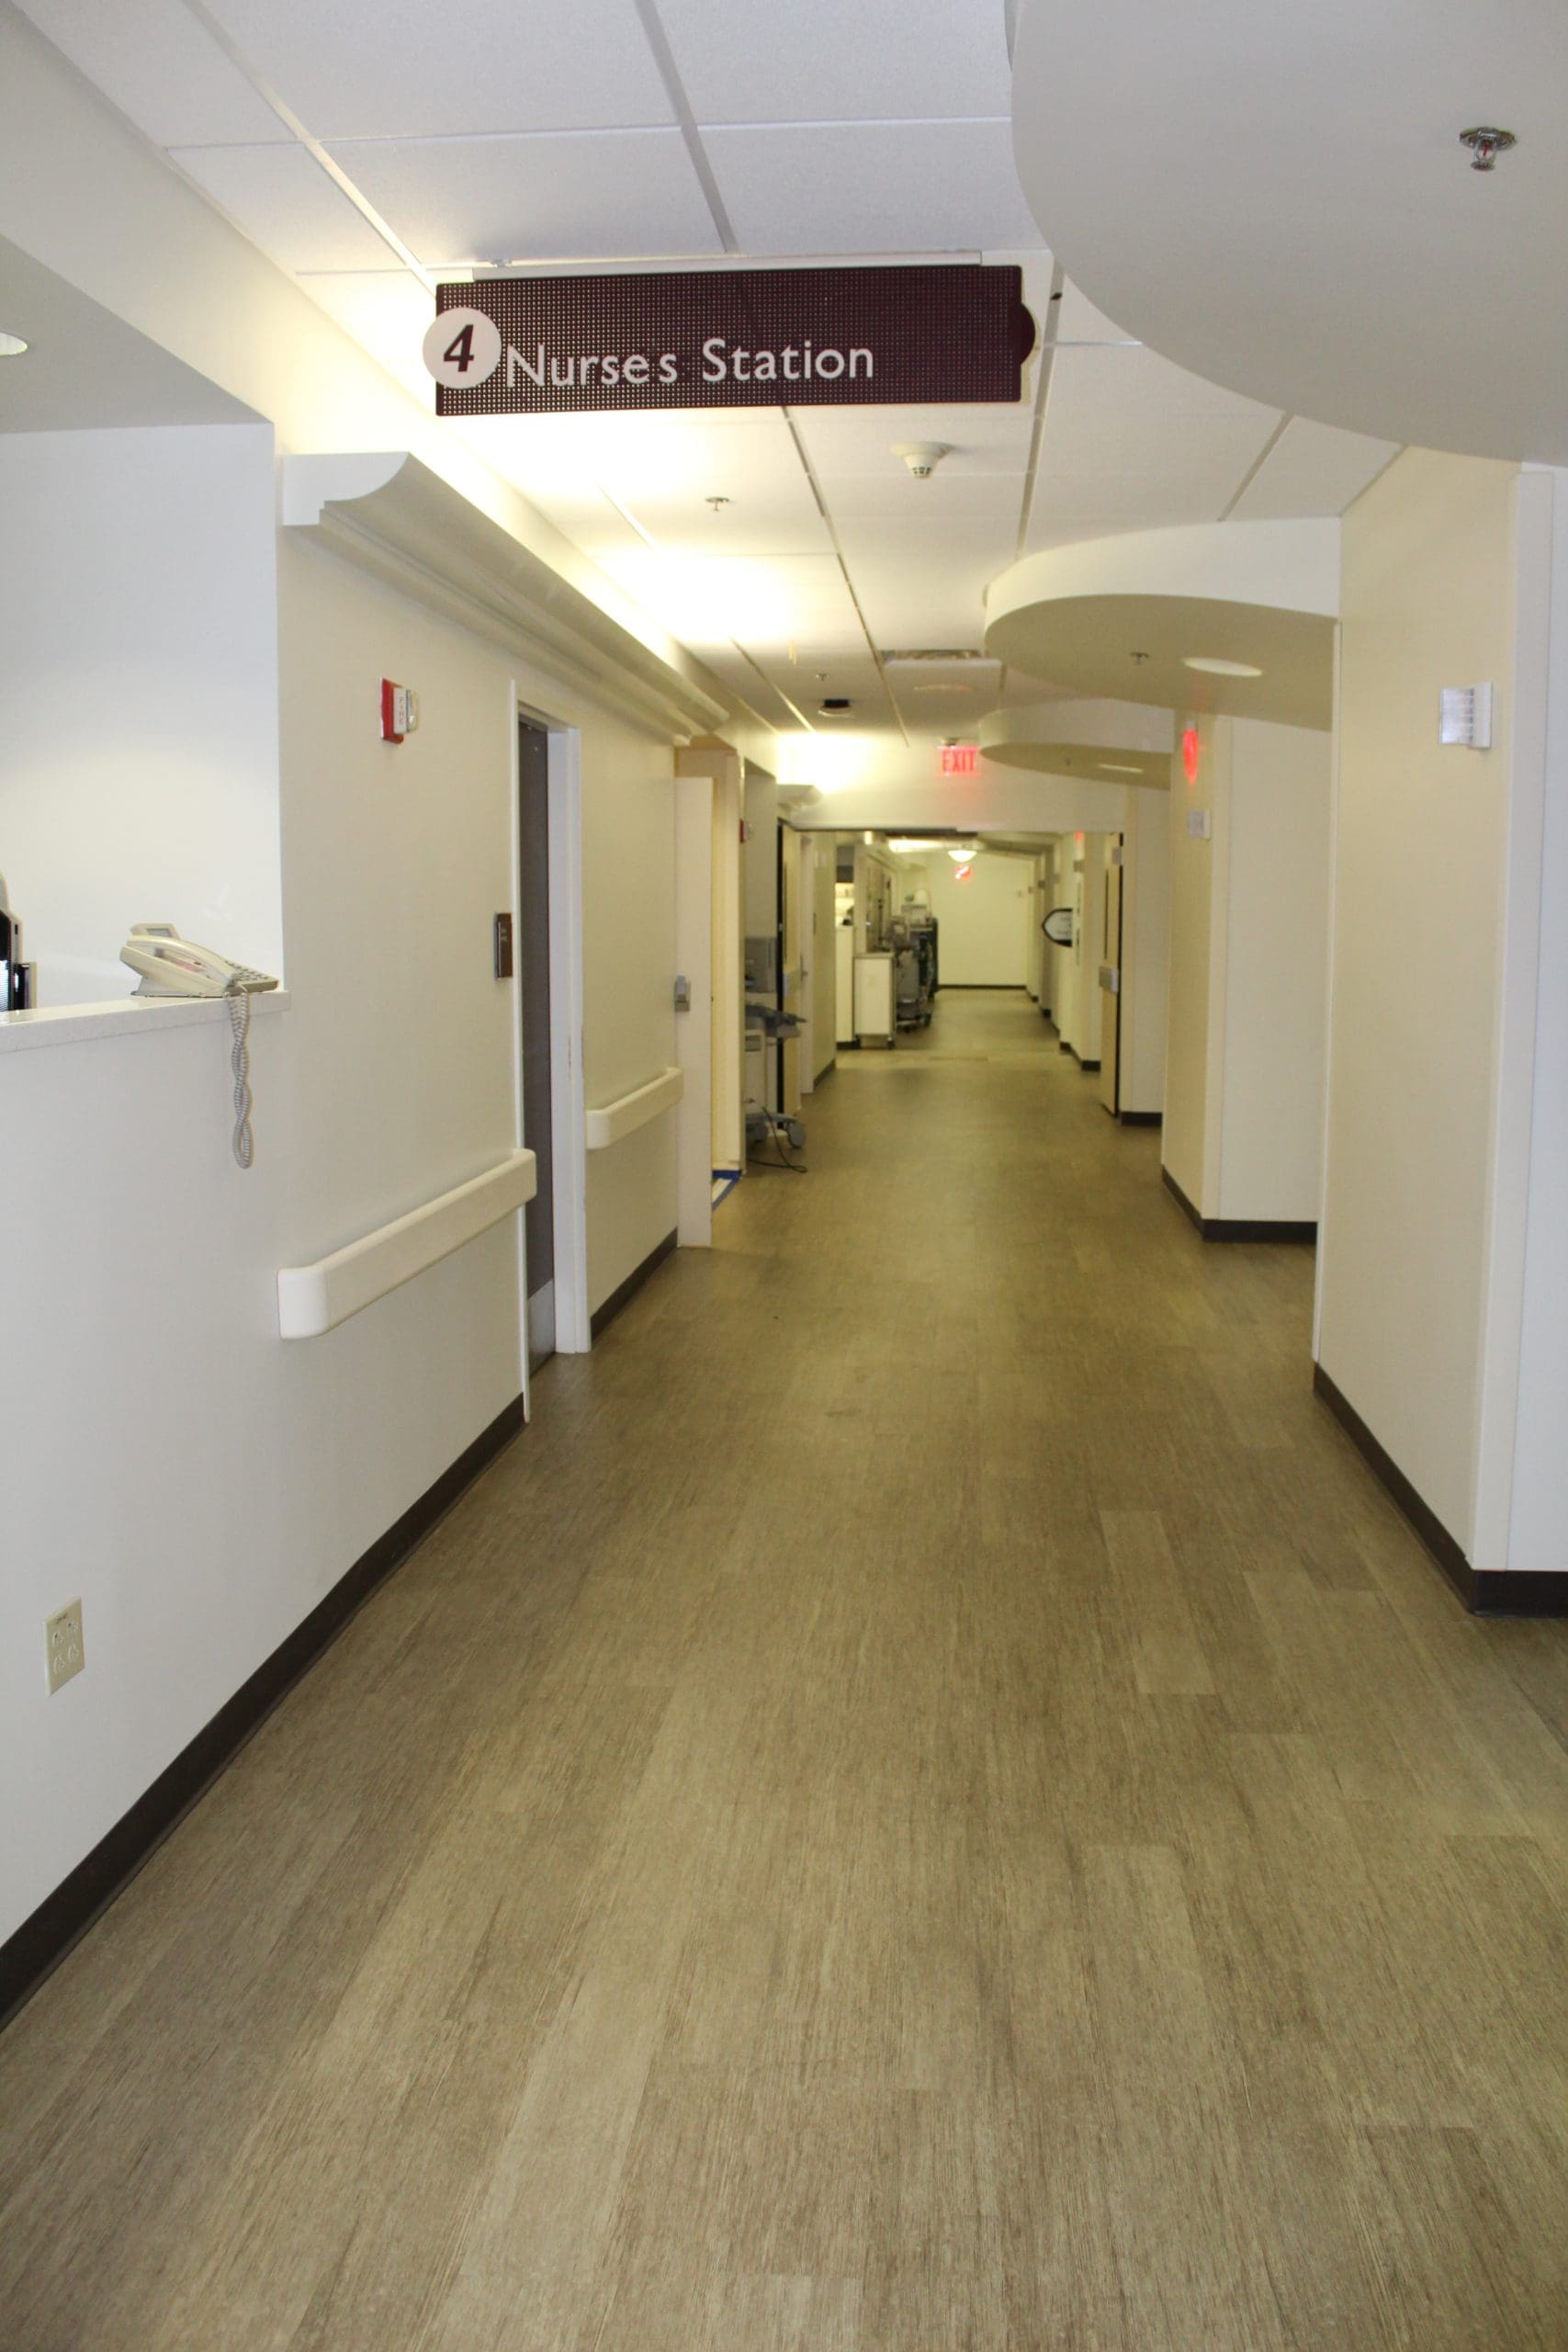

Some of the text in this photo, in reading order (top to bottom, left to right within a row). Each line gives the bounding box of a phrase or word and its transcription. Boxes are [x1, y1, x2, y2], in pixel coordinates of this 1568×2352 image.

[443, 323, 873, 388] 4 Nurses Station
[942, 749, 977, 772] EXIT
